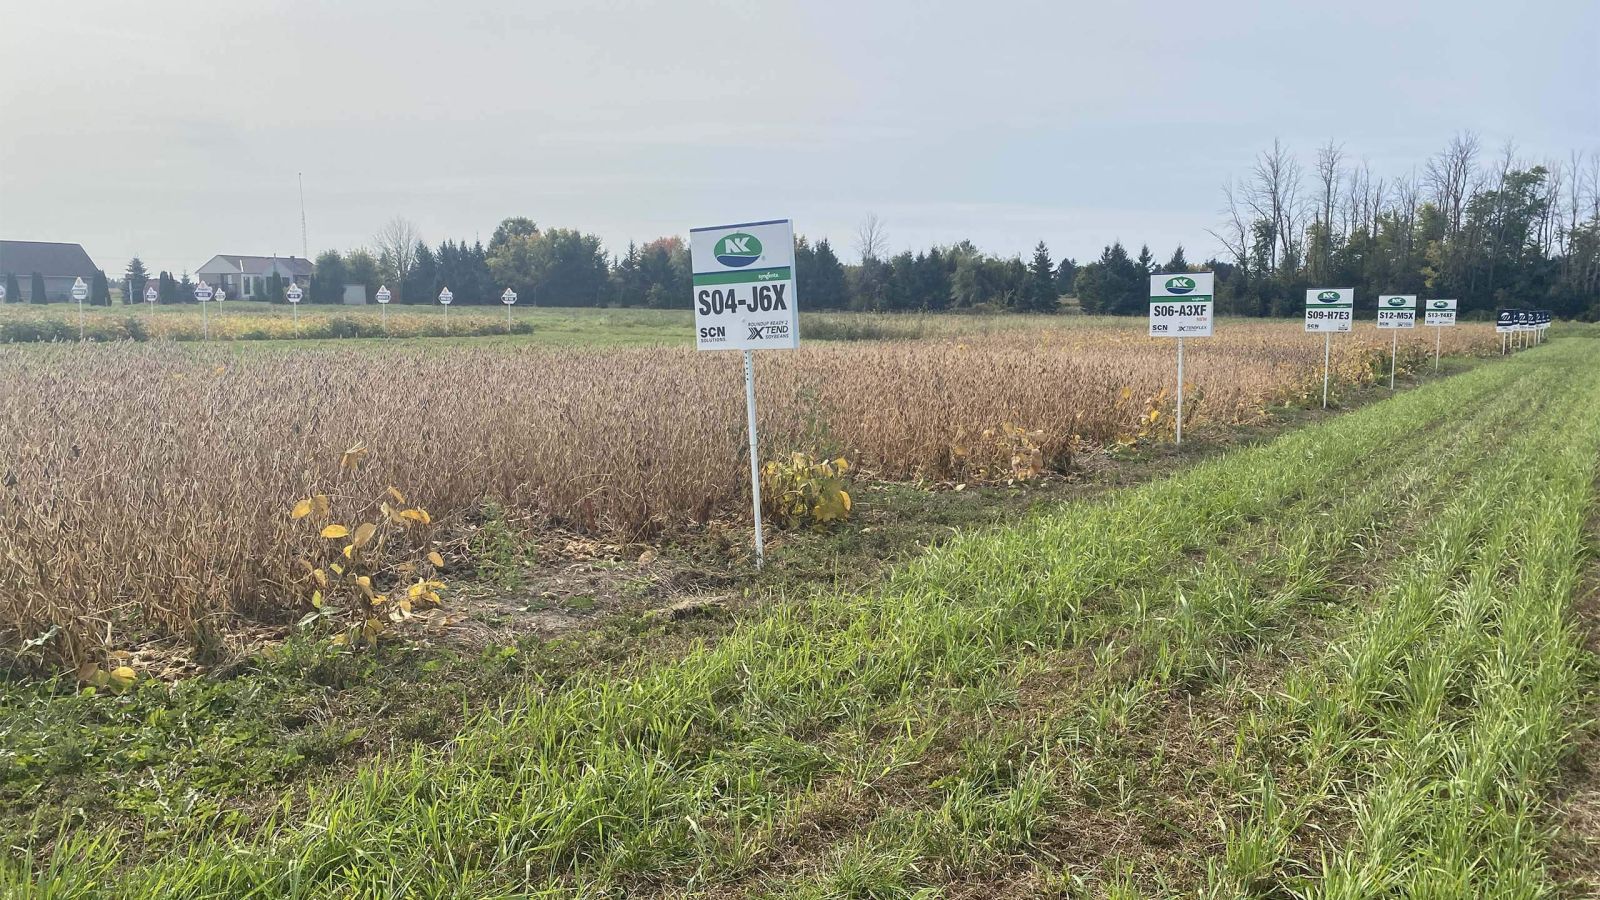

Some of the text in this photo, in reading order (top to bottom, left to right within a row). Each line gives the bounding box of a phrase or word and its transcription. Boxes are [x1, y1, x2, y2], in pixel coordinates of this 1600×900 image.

[725, 236, 751, 253] NK
[1172, 279, 1188, 287] NK
[698, 283, 788, 316] S04-J6X
[1154, 305, 1207, 317] S06-A3XF
[1307, 311, 1349, 320] S09-H7E3
[700, 326, 726, 338] SCN
[752, 326, 788, 340] XTEND
